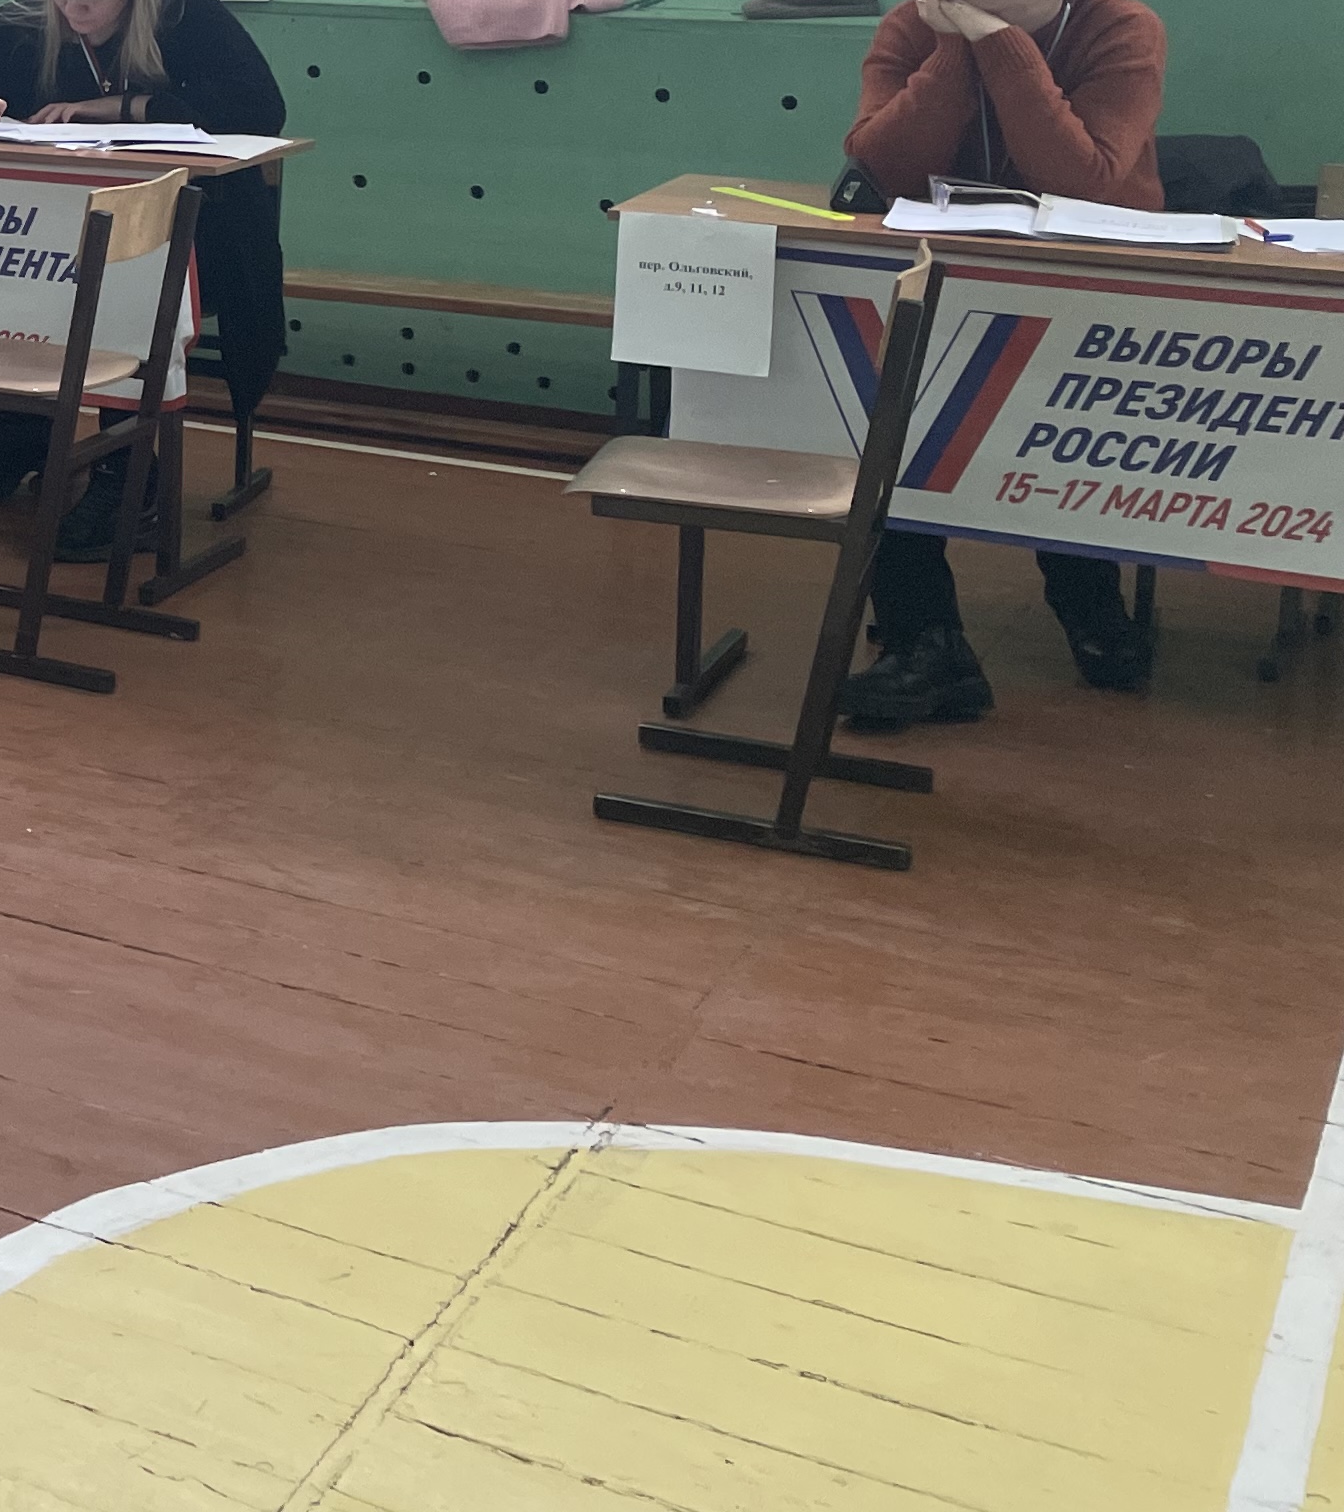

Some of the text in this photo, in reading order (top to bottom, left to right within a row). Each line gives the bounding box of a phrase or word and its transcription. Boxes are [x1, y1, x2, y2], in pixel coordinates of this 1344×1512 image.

[638, 261, 753, 280] пер. Ольговский,
[690, 283, 708, 296] 11,
[713, 285, 725, 296] 12
[1073, 323, 1323, 381] ВЫБОРЫ
[1016, 422, 1237, 482] РОССИИ
[1100, 484, 1233, 531] МАРТА
[1236, 502, 1334, 543] 2024
